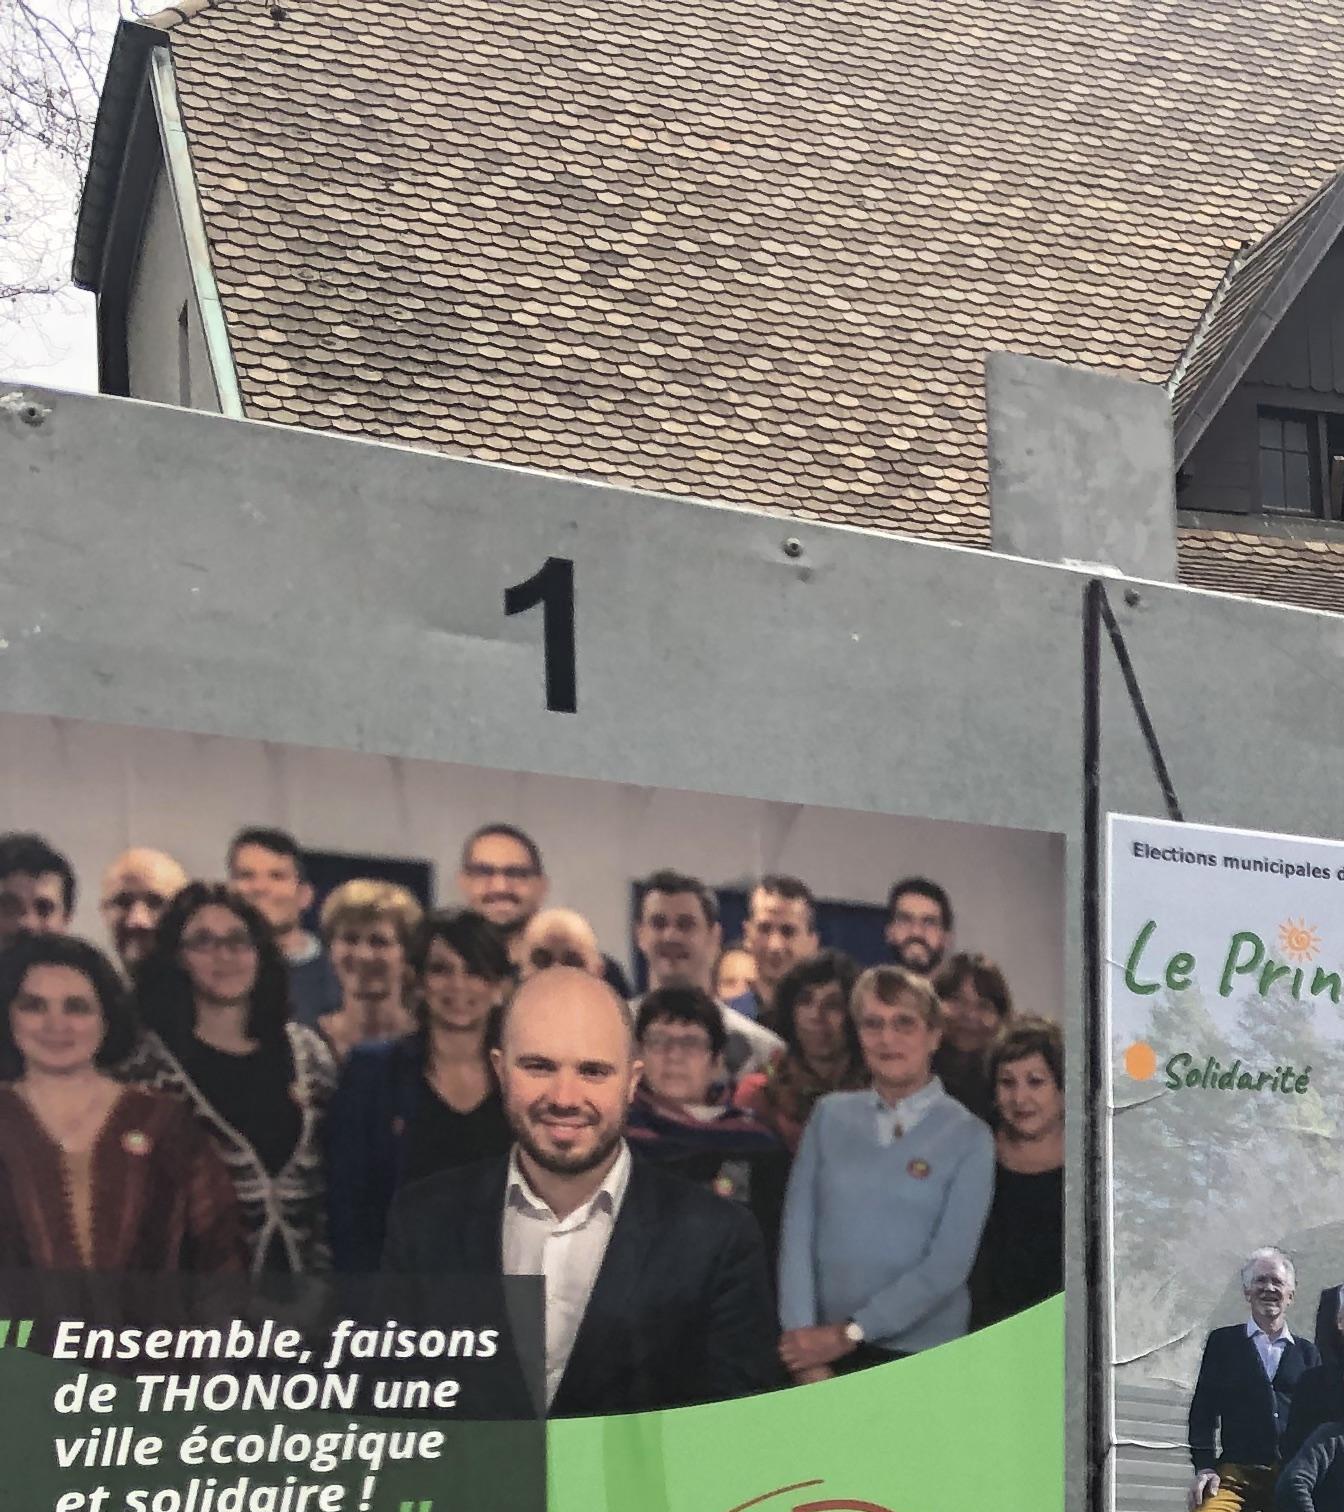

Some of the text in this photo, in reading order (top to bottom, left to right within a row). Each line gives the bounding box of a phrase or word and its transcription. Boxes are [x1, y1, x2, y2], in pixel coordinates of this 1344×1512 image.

[504, 557, 577, 714] 1
[1132, 841, 1217, 867] Elections
[1224, 854, 1330, 879] municipales
[1125, 920, 1195, 995] Le
[1165, 1053, 1312, 1095] Solidarité
[53, 1320, 498, 1370] Ensemble, faisons
[53, 1373, 460, 1415] de THONON une
[53, 1418, 445, 1472] ville écologique
